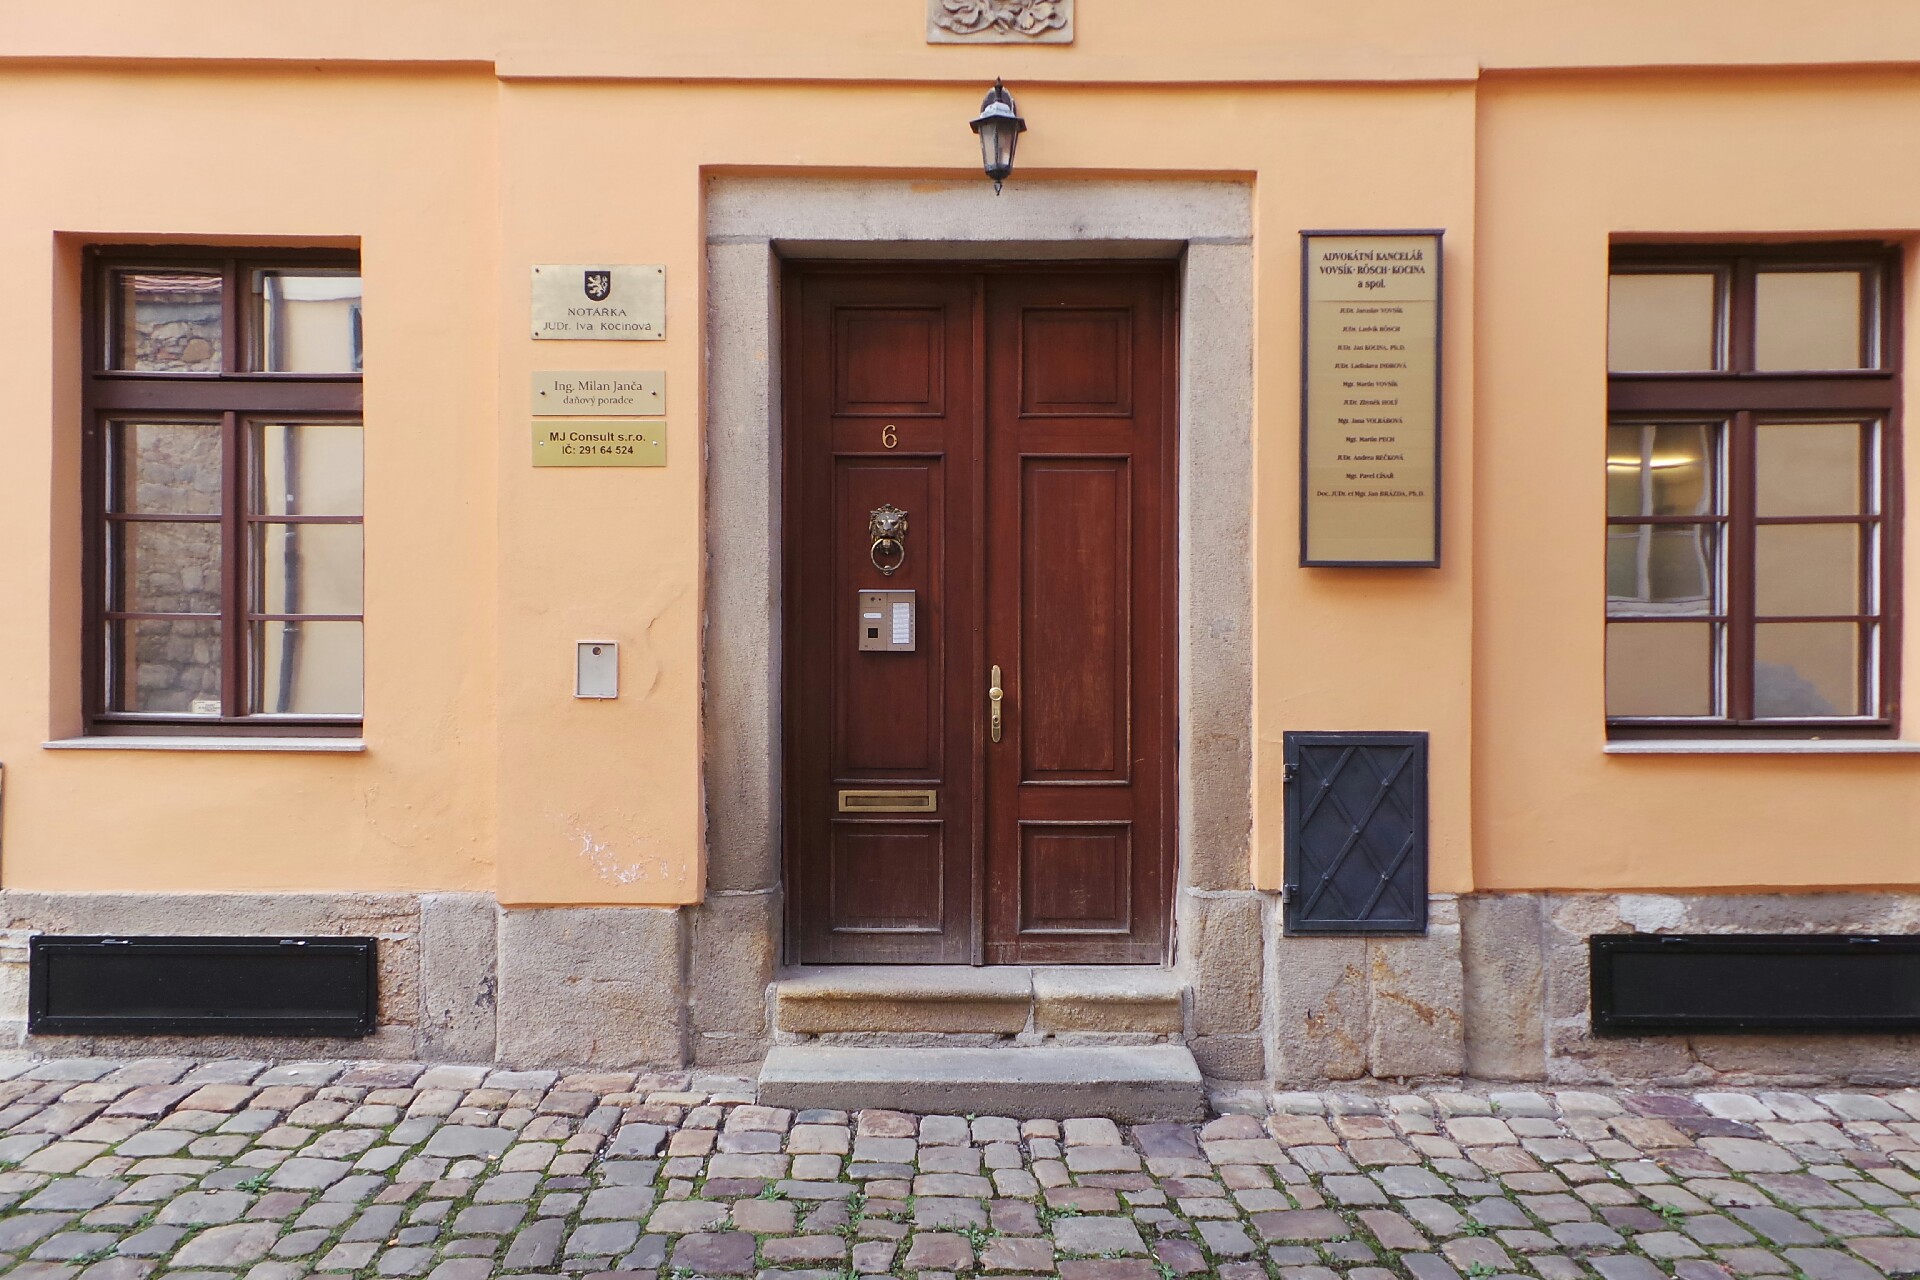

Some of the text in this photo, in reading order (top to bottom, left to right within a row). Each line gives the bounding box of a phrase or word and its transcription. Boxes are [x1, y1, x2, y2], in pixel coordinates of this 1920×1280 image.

[1322, 250, 1423, 261] ADVOKÁTNÍ KANCELÁŘ
[1392, 265, 1425, 274] KOCINA
[1365, 279, 1386, 290] spol.
[567, 307, 627, 317] NOTÁŘKA
[543, 322, 652, 331] JUDr. Iva Kocinová
[554, 381, 642, 393] Ing. Milan Janča
[563, 396, 634, 406] daňový poradce
[549, 432, 646, 441] MJ Consult s.r.o.
[882, 424, 898, 449] 6
[562, 444, 634, 454] IČ: 291 64 524
